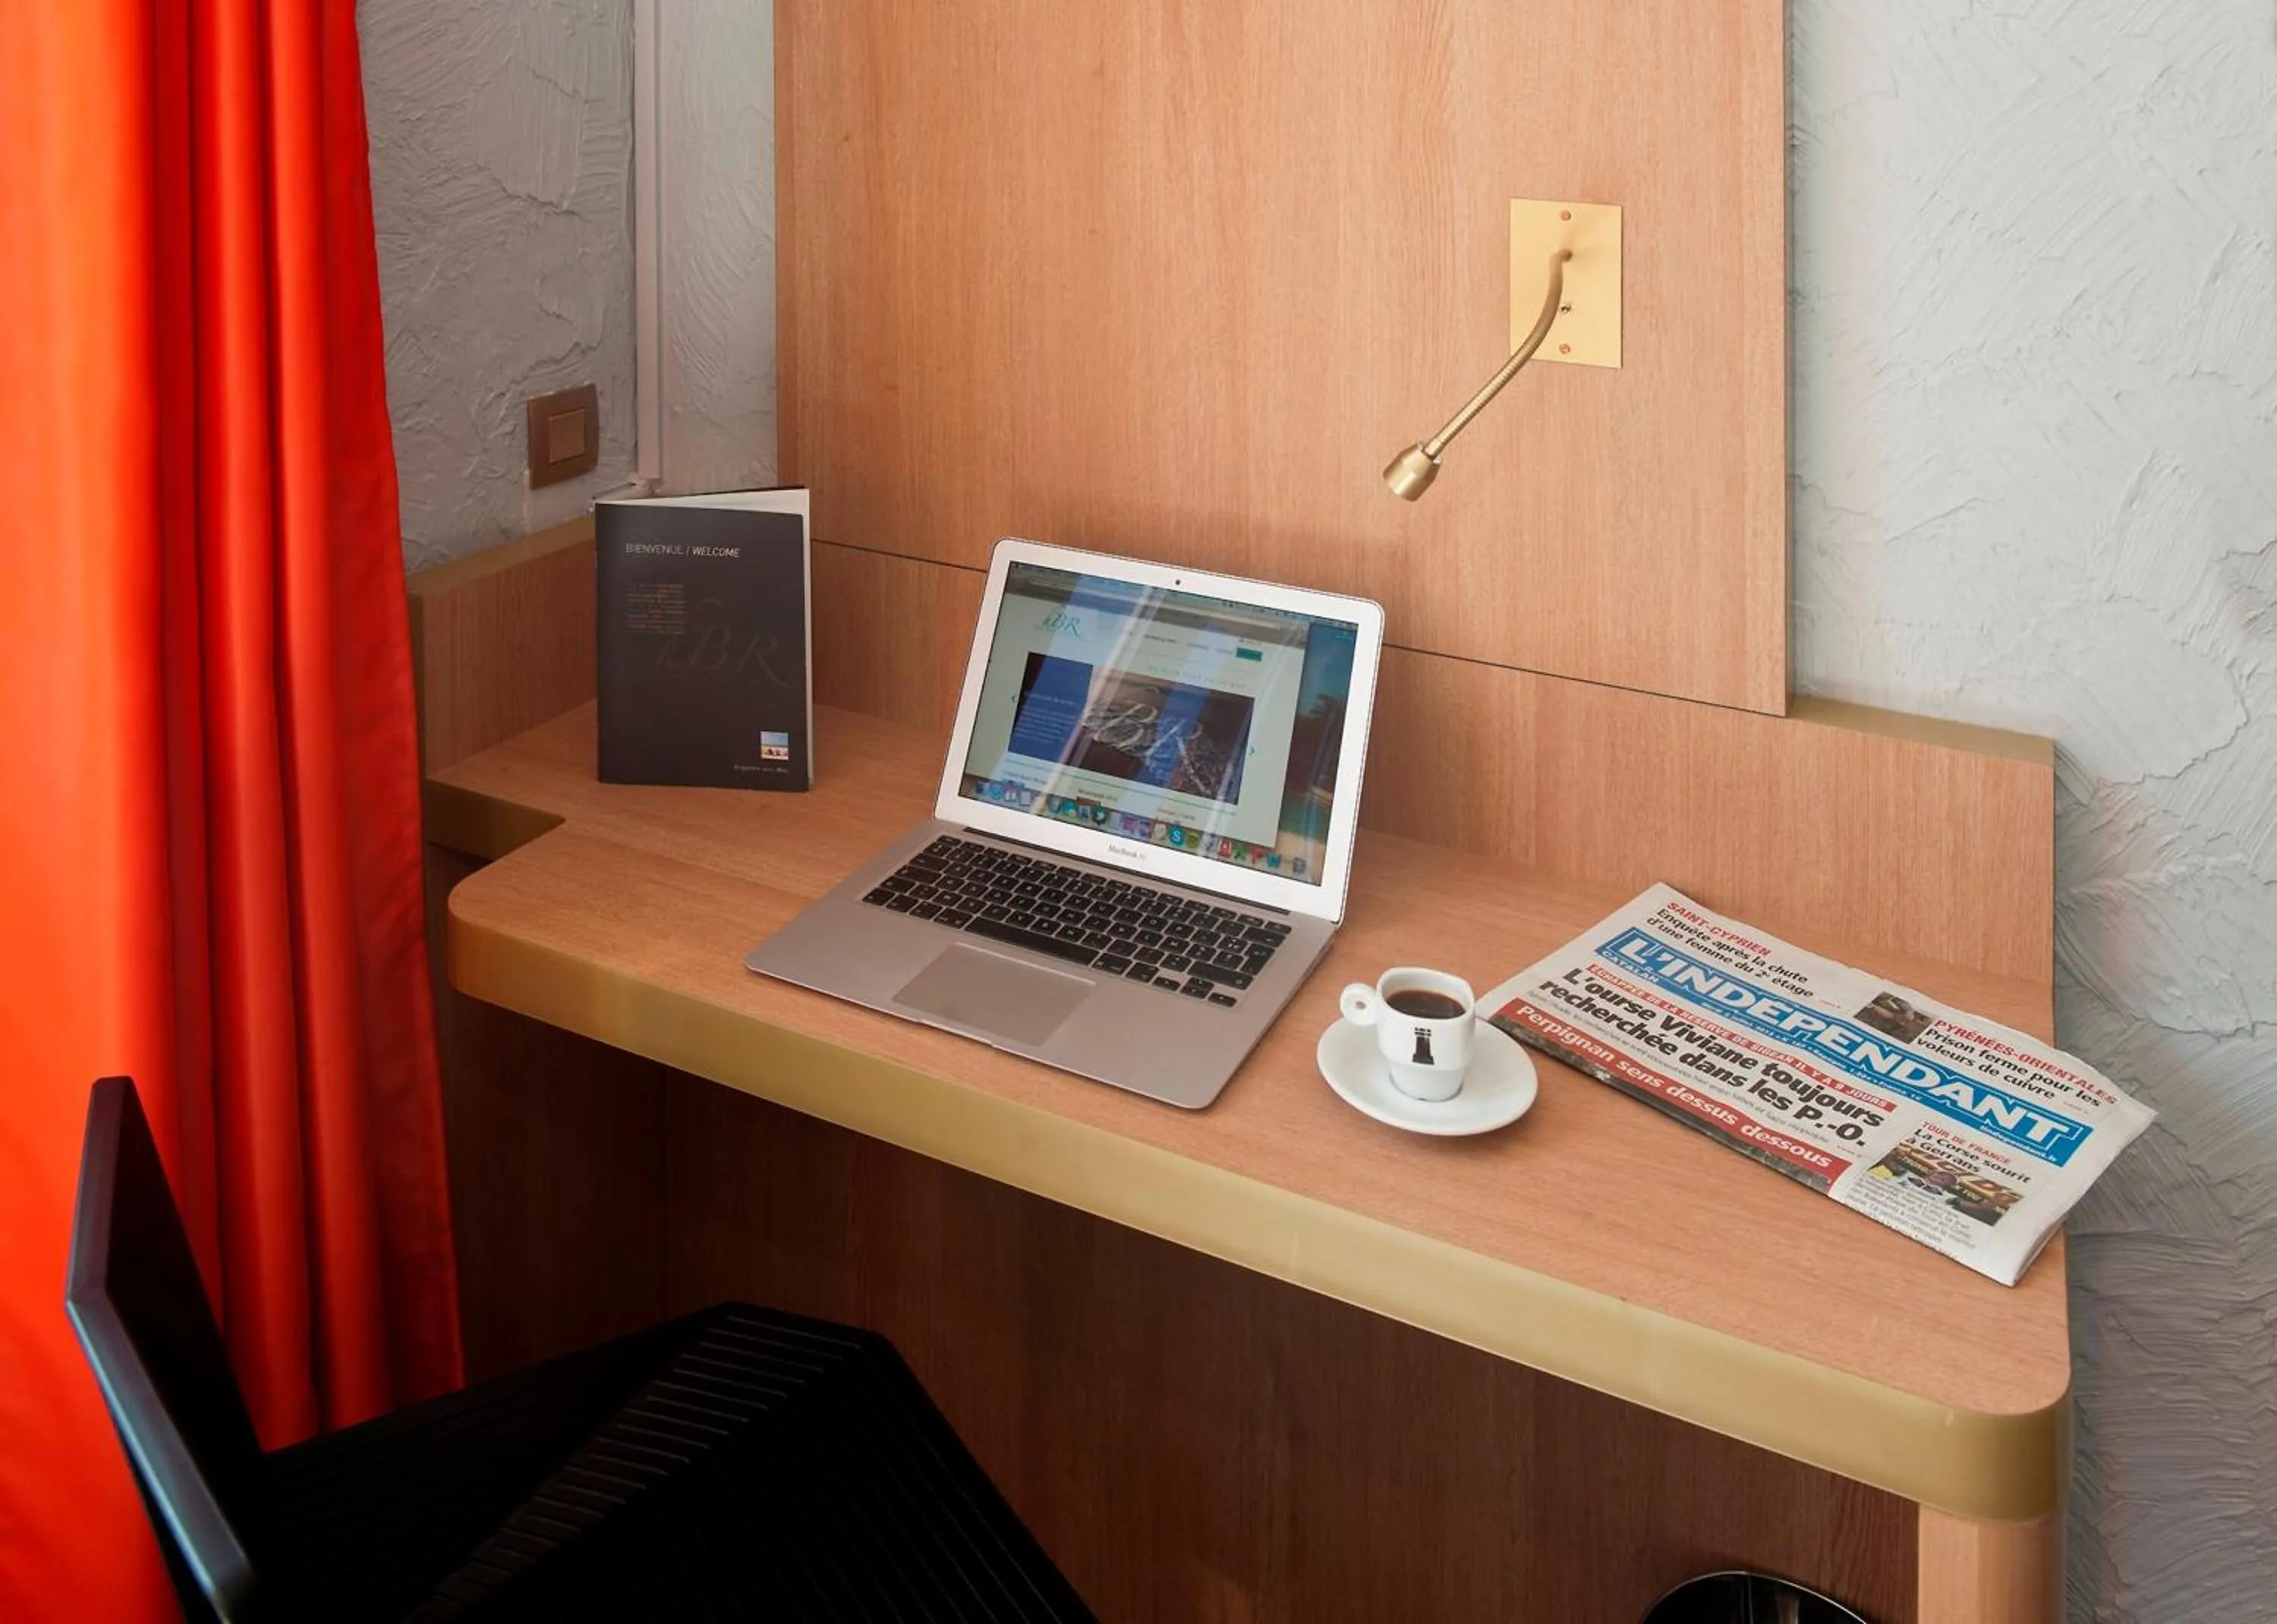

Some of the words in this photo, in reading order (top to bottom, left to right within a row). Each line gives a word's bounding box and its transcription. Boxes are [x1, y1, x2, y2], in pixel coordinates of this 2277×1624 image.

[625, 542, 684, 555] BIENVENUE
[691, 546, 741, 558] WELCOME
[1657, 908, 1710, 942] Enquête
[1712, 940, 1750, 960] après
[1752, 955, 1766, 968] la
[1768, 962, 1808, 984] chute
[1667, 902, 1772, 956] SAINT-CYPRIEN
[1601, 950, 1660, 984] CATALAN
[1686, 937, 1733, 964] femme
[1734, 959, 1754, 973] du
[1772, 977, 1813, 998] étage
[1539, 981, 1677, 1056] recherchée
[1679, 1052, 1747, 1087] dans
[1748, 1079, 1793, 1111] les
[1794, 1104, 1866, 1147] P.-O.
[1564, 968, 1657, 1021] L'ourse
[1660, 1015, 1759, 1069] Viviane
[1761, 1062, 1885, 1127] toujours
[1916, 1038, 1976, 1066] voleurs
[1979, 1063, 1999, 1077] de
[2004, 1074, 2055, 1099] cuivre
[1926, 1028, 1974, 1054] Prison
[1979, 1049, 2028, 1075] ferme
[2030, 1072, 2074, 1094] pour
[2076, 1090, 2102, 1107] les
[1934, 1019, 2118, 1104] PYRÉNÉES-ORIENTALES
[1517, 1006, 1614, 1062] Perpignan
[1617, 1060, 1662, 1089] sens
[1668, 1083, 1739, 1125] dessus
[1740, 1125, 1833, 1167] dessous
[1844, 1086, 1889, 1108] JOURS
[1906, 1137, 1916, 1145] à
[1920, 1140, 1981, 1174] Gerrans
[1914, 1128, 1934, 1141] La
[1936, 1137, 1979, 1161] Corse
[1982, 1157, 2031, 1184] sourit
[1923, 1121, 1949, 1138] TOUR
[1951, 1135, 1966, 1145] DE
[1967, 1141, 2011, 1164] FRANCE
